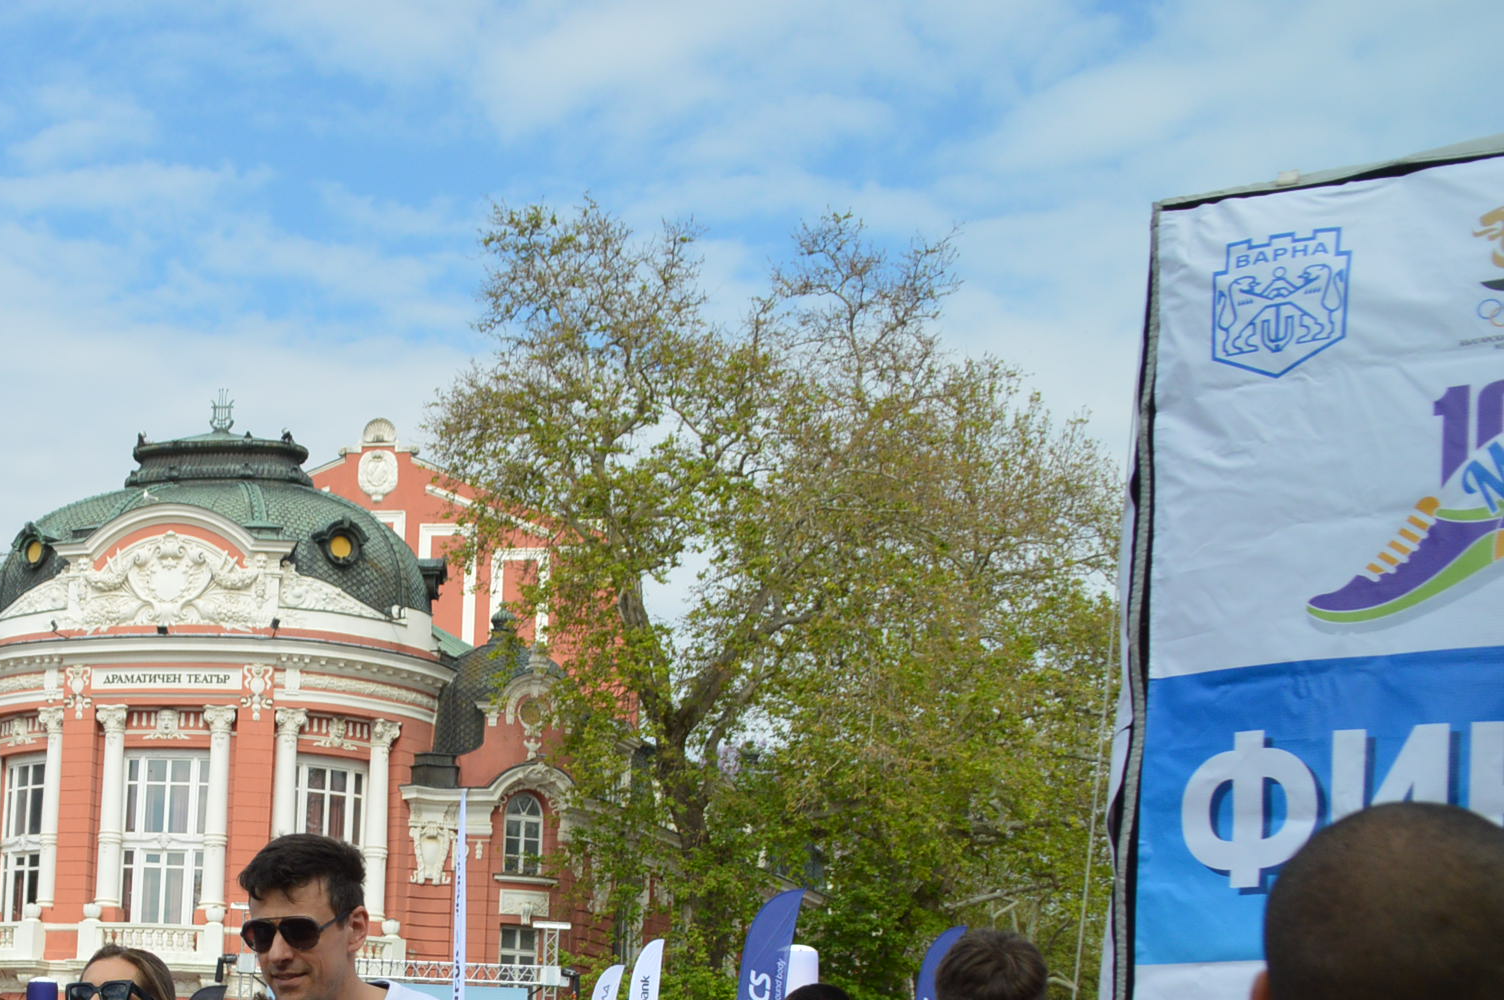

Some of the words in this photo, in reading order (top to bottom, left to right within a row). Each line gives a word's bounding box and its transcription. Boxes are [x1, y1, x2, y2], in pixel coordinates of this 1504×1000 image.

[1235, 241, 1330, 269] ВАРНА
[102, 673, 182, 685] ДРАМАТИЧЕН
[186, 673, 231, 684] ТЕАТЪР
